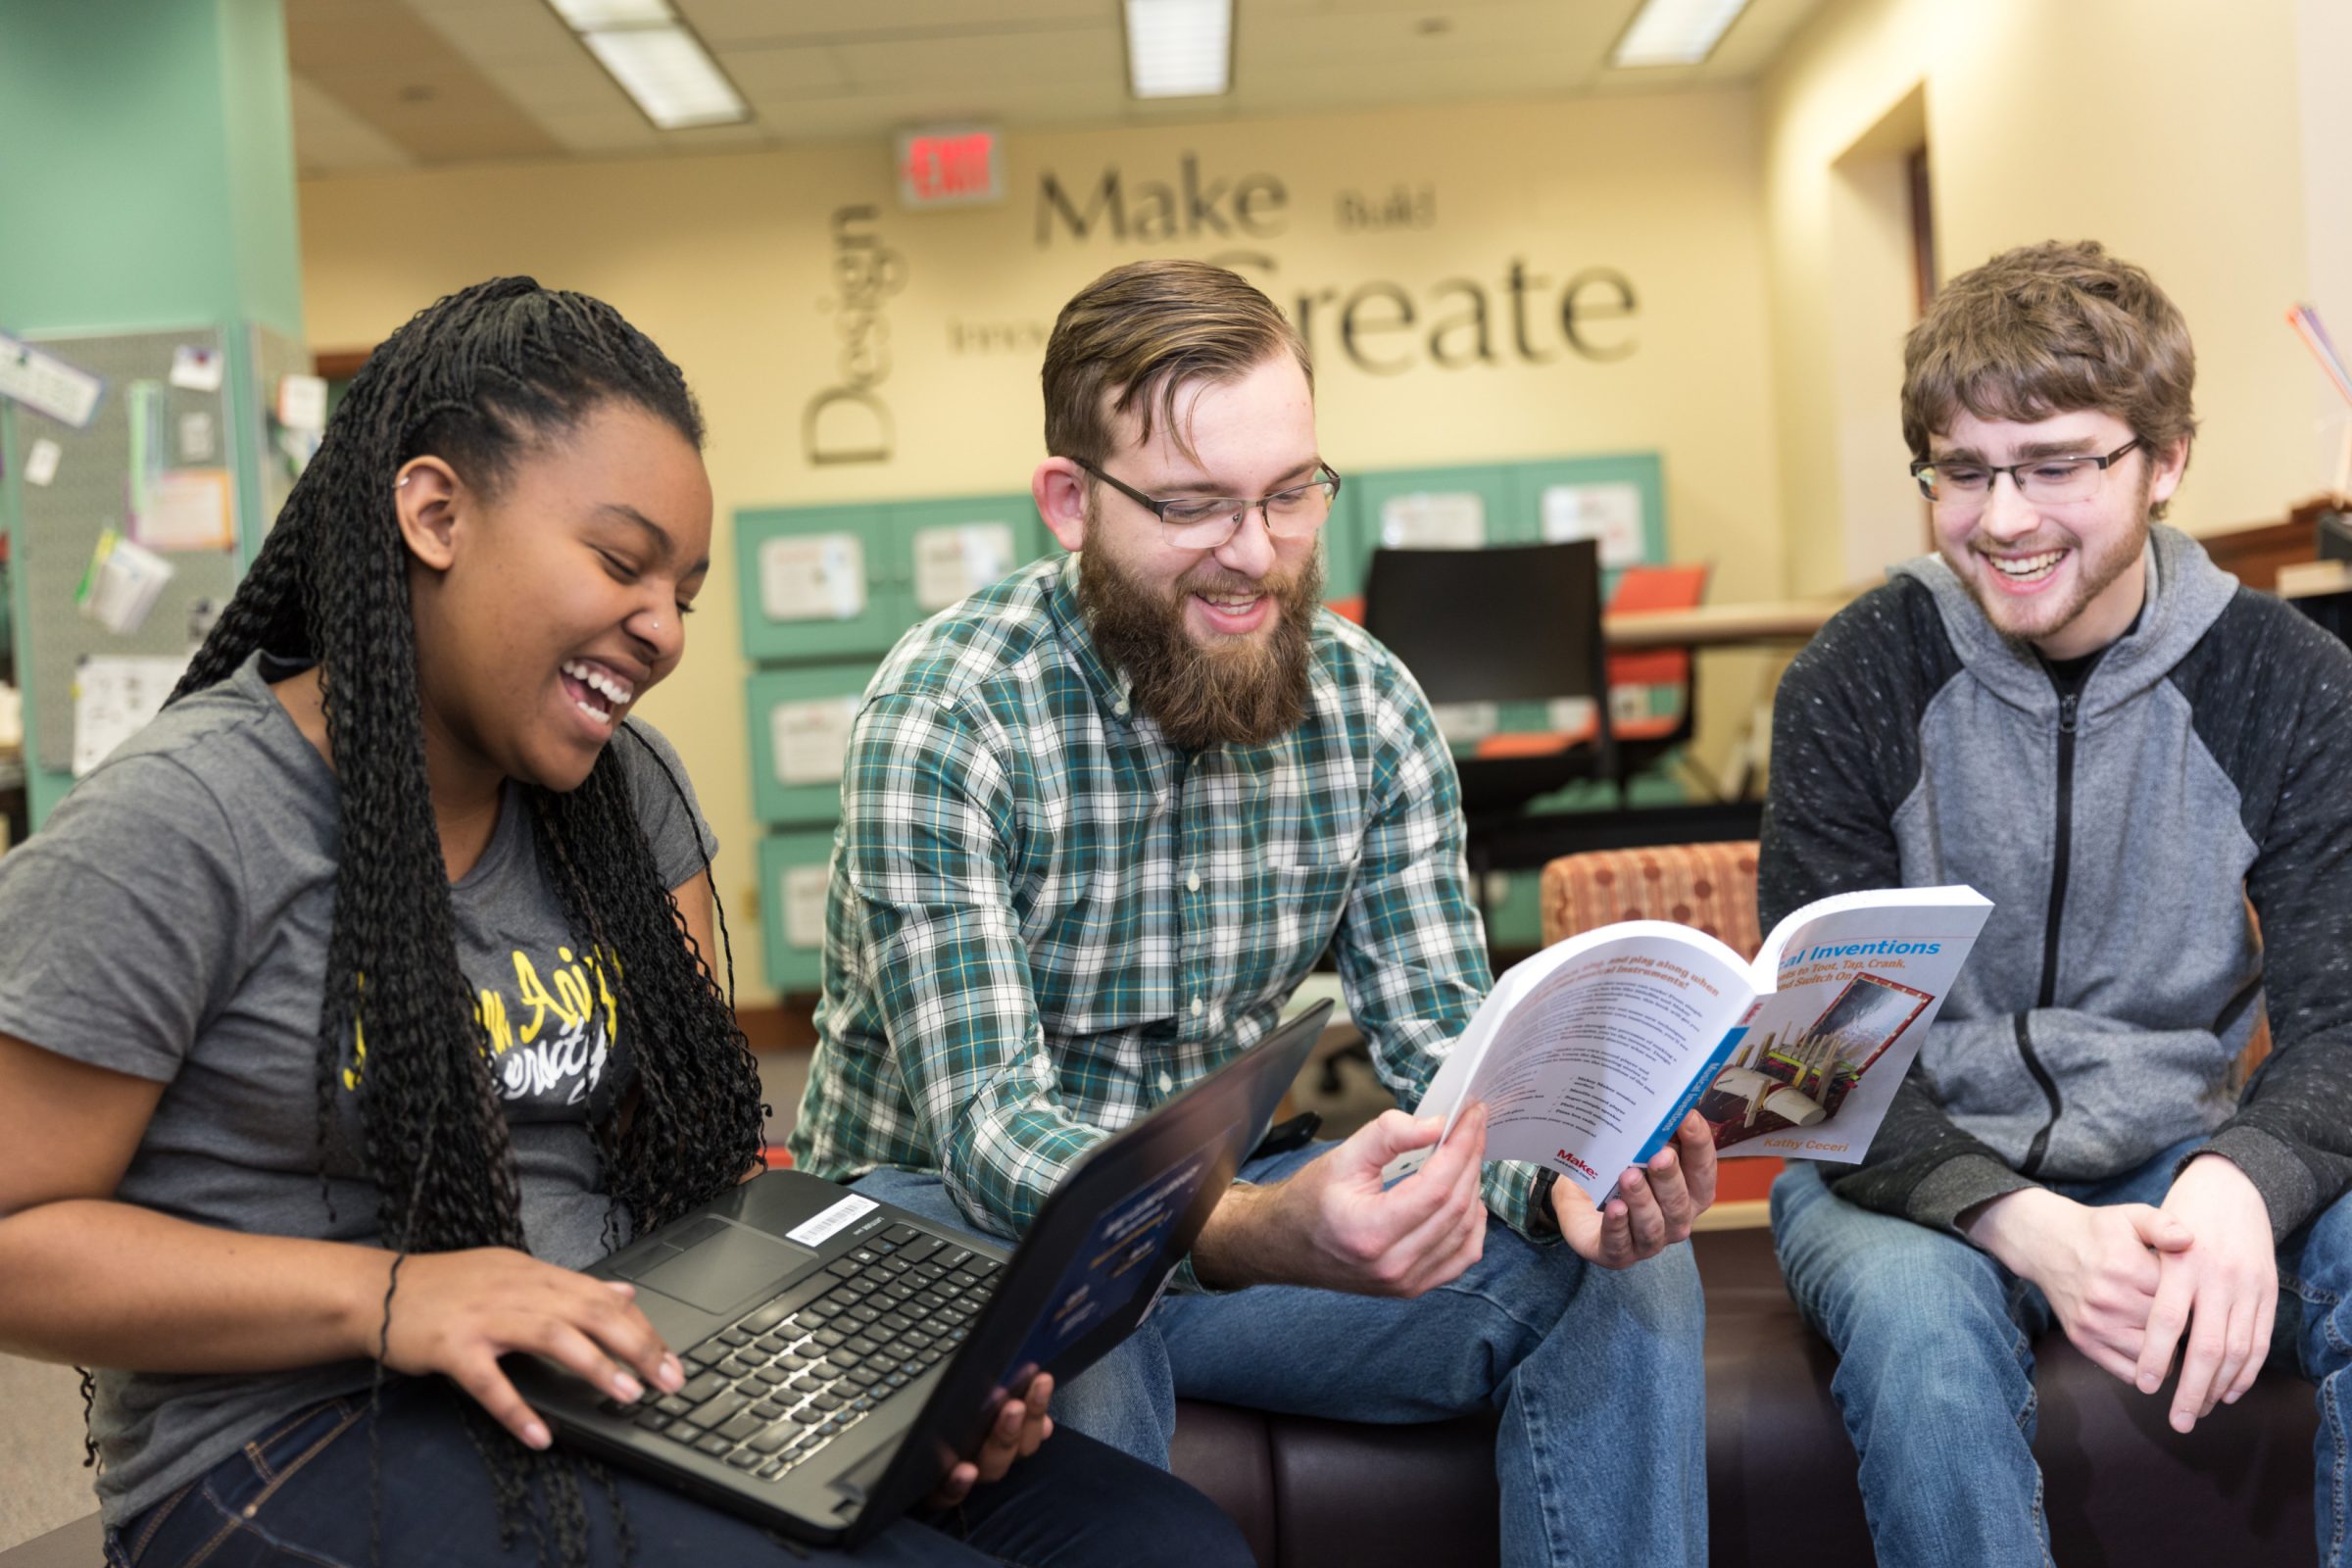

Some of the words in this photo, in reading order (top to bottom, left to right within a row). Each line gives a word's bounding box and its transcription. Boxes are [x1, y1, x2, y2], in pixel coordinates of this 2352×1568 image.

[1035, 153, 1286, 243] Make
[1335, 183, 1434, 230] Build
[803, 203, 904, 465] Design
[1810, 939, 1941, 961] Inventions
[1868, 958, 1905, 969] Crank,
[1629, 956, 1654, 967] play
[1656, 960, 1689, 979] along
[1690, 974, 1720, 997] when
[1794, 973, 1833, 987] Switch
[1836, 971, 1852, 981] On
[1764, 1139, 1803, 1151] Kathy
[1806, 1140, 1849, 1152] Ceceri
[1557, 1149, 1598, 1180] Make:
